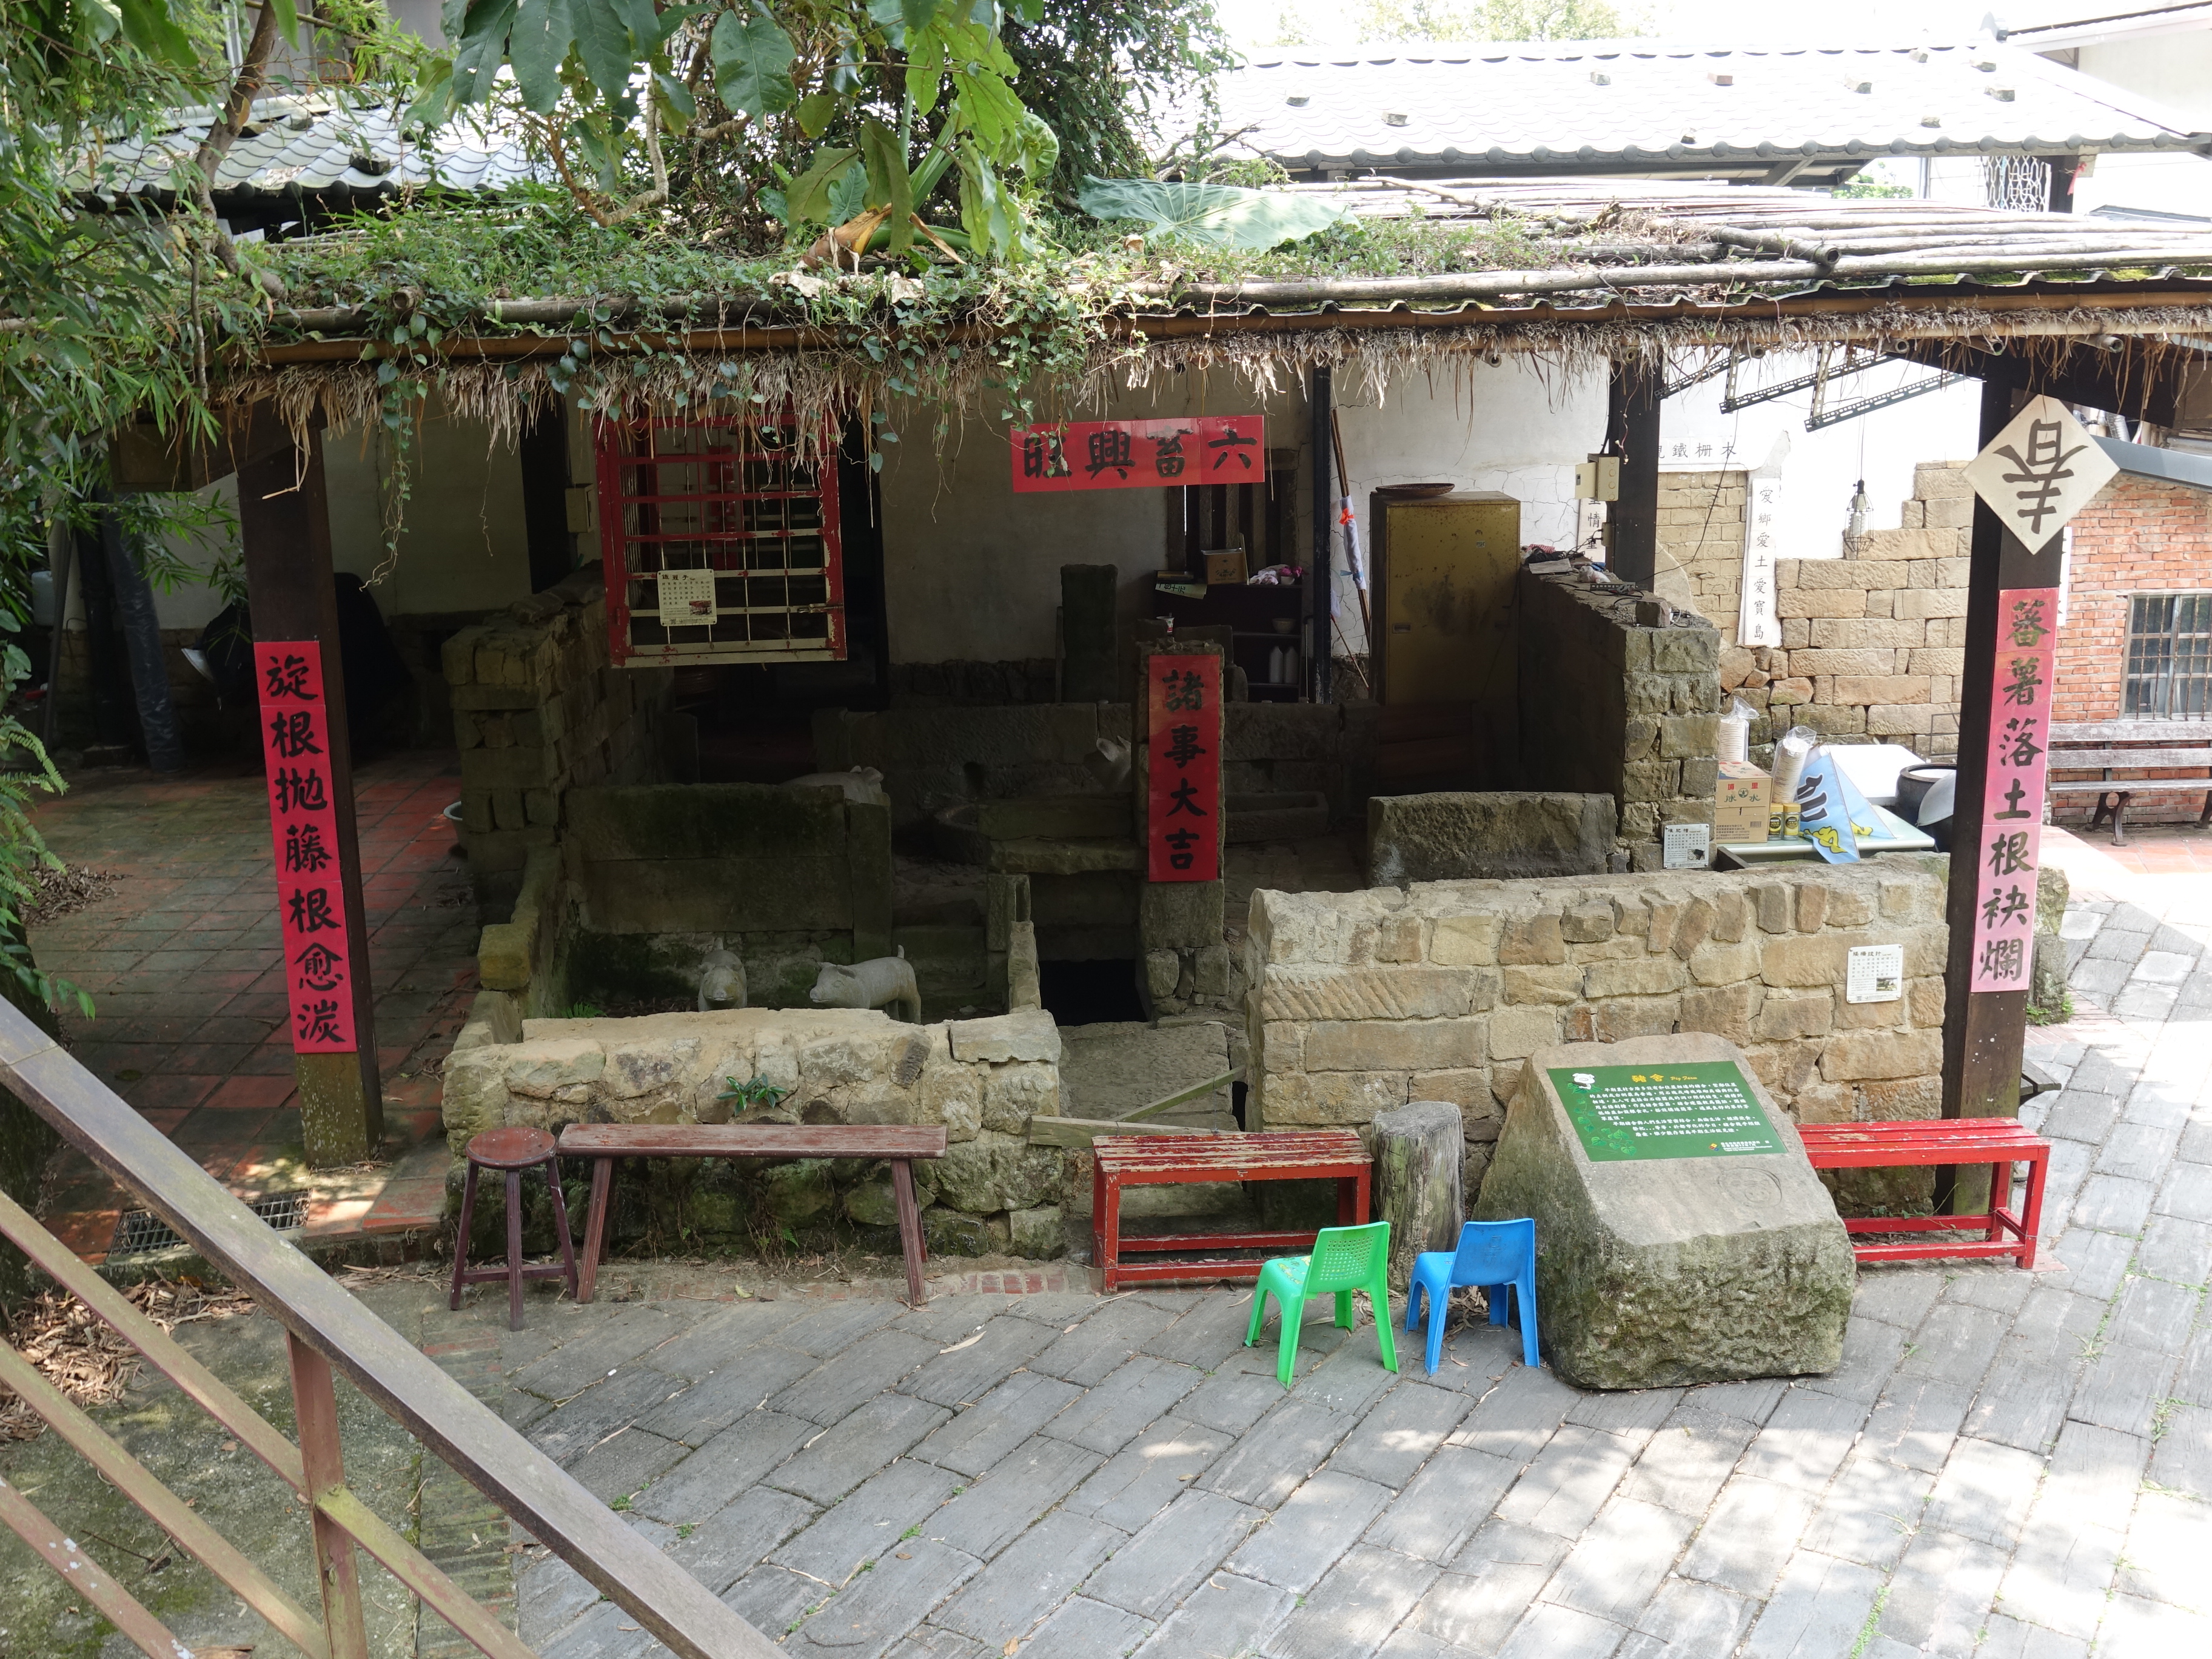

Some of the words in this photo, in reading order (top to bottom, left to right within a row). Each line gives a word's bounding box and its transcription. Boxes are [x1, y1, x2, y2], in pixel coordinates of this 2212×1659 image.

[1992, 418, 2088, 534] 春
[1754, 486, 1774, 640] 愛鄉愛土愛寶島
[1162, 669, 1208, 870] 諸事大吉
[1631, 1073, 1664, 1082] 豬舍
